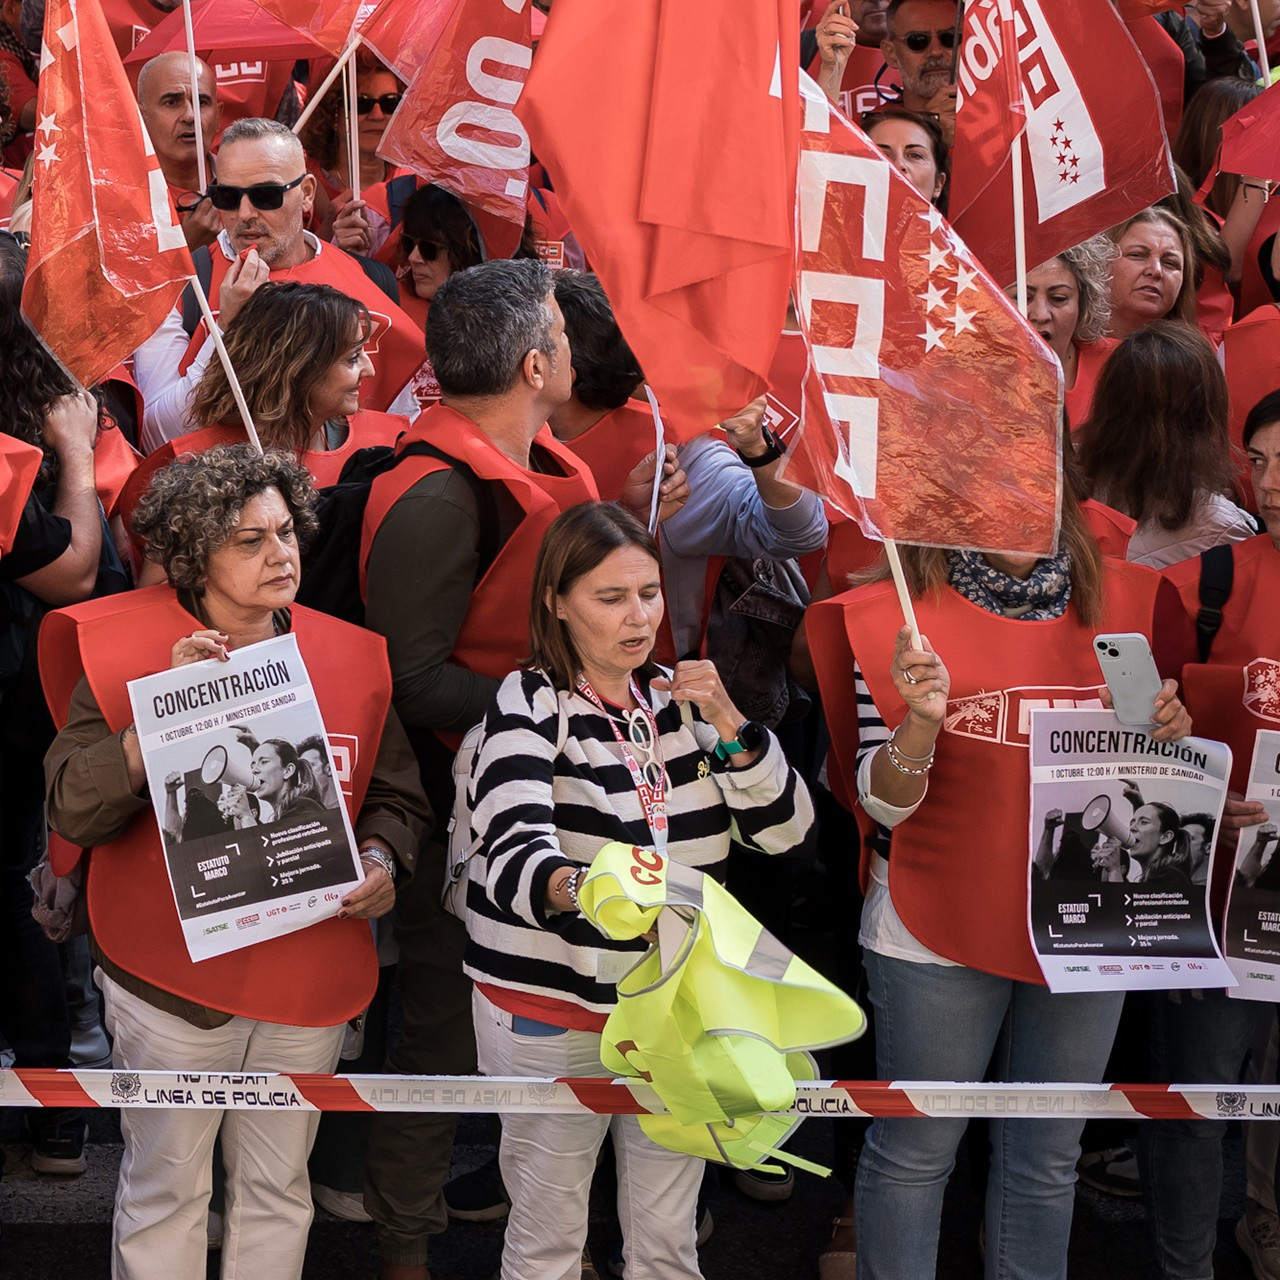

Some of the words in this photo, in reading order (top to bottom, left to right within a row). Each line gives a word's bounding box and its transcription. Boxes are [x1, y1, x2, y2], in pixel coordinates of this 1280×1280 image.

[153, 659, 291, 719] CONCENTRACIÓN
[165, 727, 193, 742] OCTUBRE
[195, 719, 213, 732] 12:00
[225, 704, 262, 723] MINISTERIO
[262, 701, 271, 712] DE
[271, 692, 297, 710] SANIDAD
[1050, 730, 1208, 770] CONCENTRACIÓN
[1056, 768, 1084, 778] OCTUBRE
[1087, 767, 1105, 777] 12:00
[1105, 767, 1111, 776] H
[1117, 766, 1157, 775] MINISTERIO
[1159, 767, 1168, 776] DE
[1170, 768, 1204, 781] SANIDAD
[197, 855, 230, 872] ESTATUTO
[203, 866, 228, 882] MARCO
[266, 908, 281, 918] UGT
[1058, 903, 1089, 914] ESTATUTO
[1062, 914, 1086, 924] MARCO
[144, 1088, 197, 1105] LINEA
[202, 1089, 227, 1105] DE
[232, 1091, 300, 1107] POLICIA
